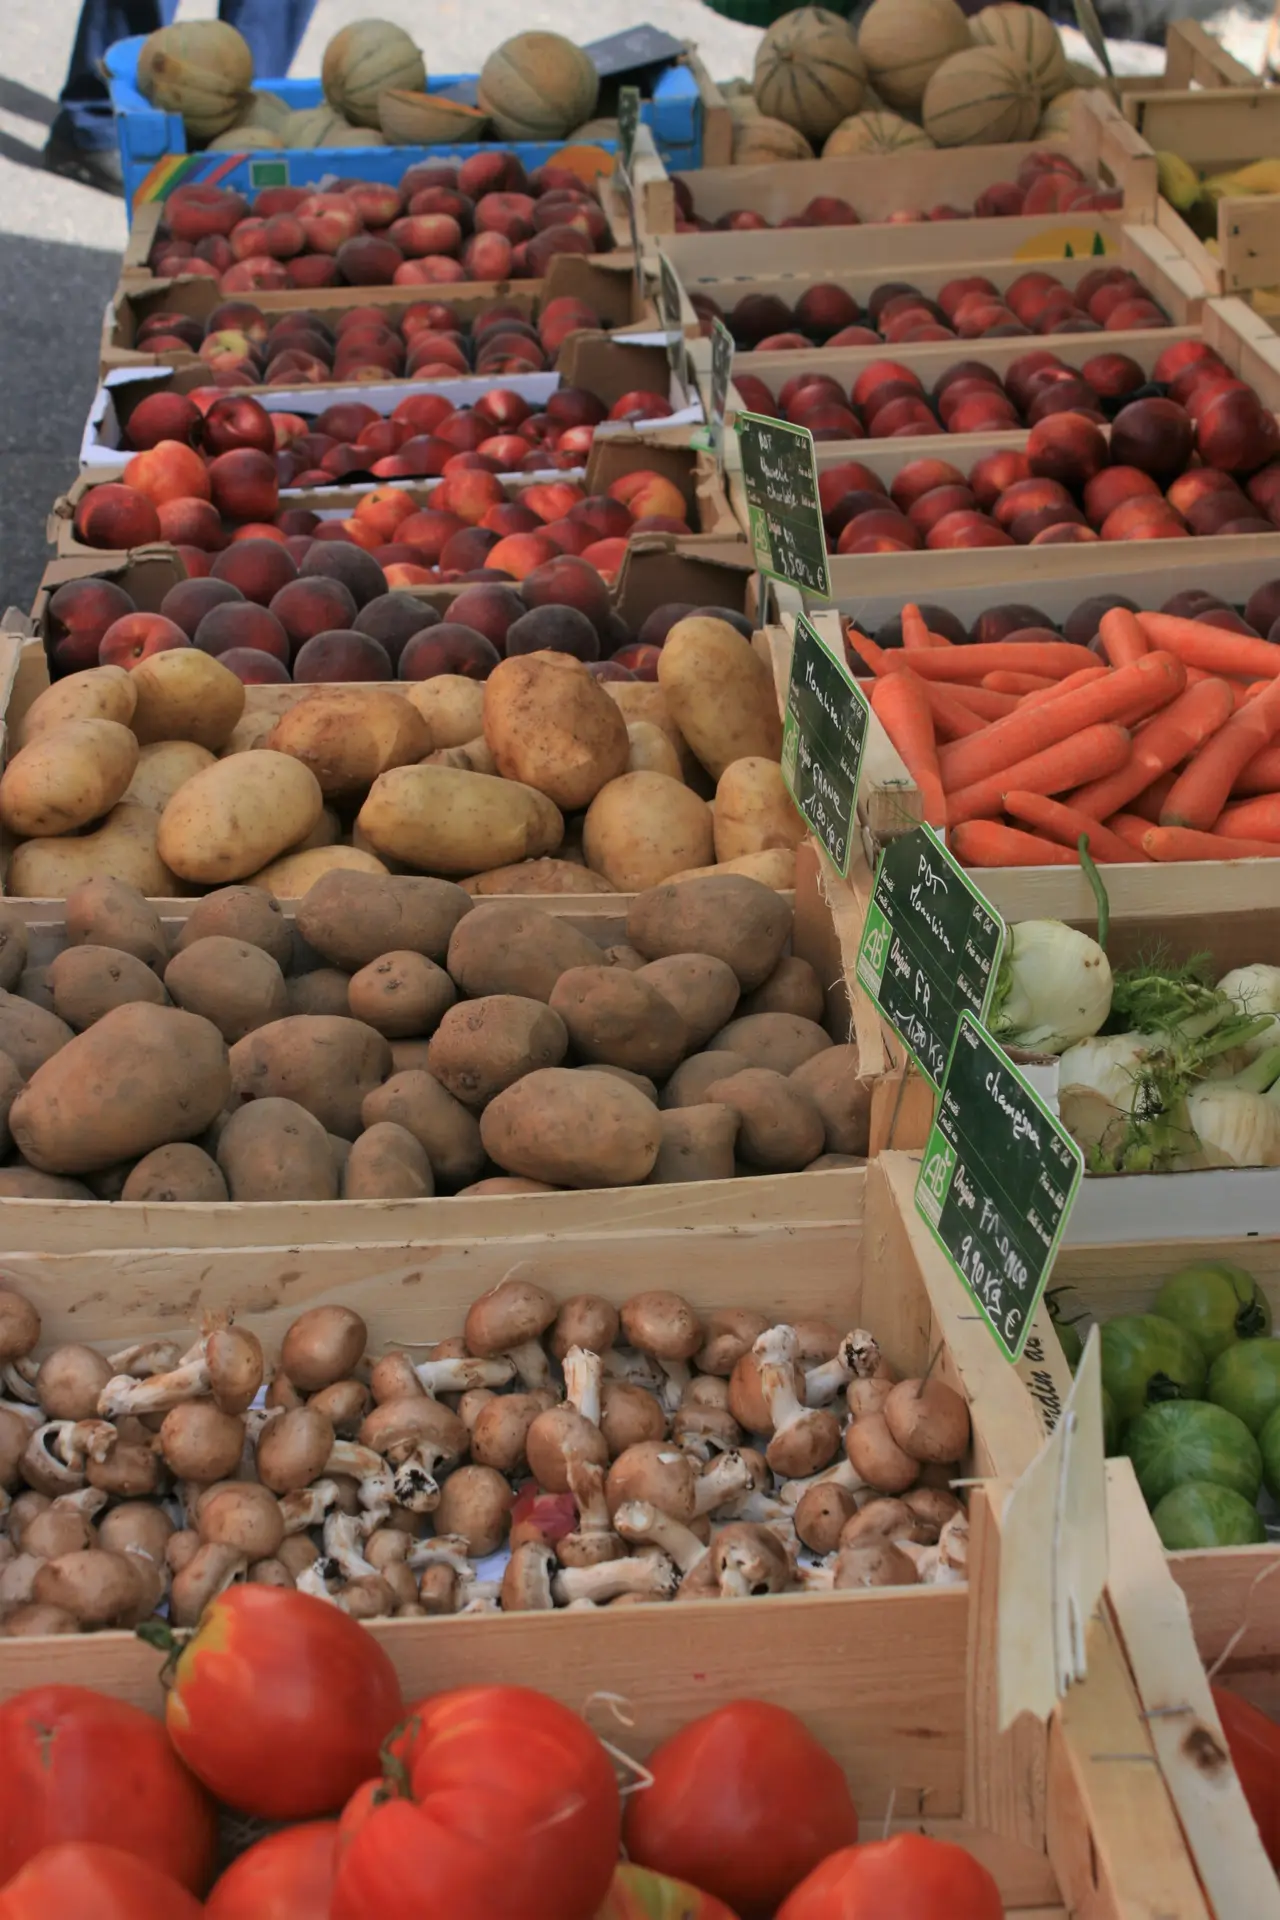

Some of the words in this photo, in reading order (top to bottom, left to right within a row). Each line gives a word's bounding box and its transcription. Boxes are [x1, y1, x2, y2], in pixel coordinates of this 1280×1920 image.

[836, 837, 844, 861] €
[924, 1153, 946, 1197] AB
[1004, 1309, 1021, 1339] €
